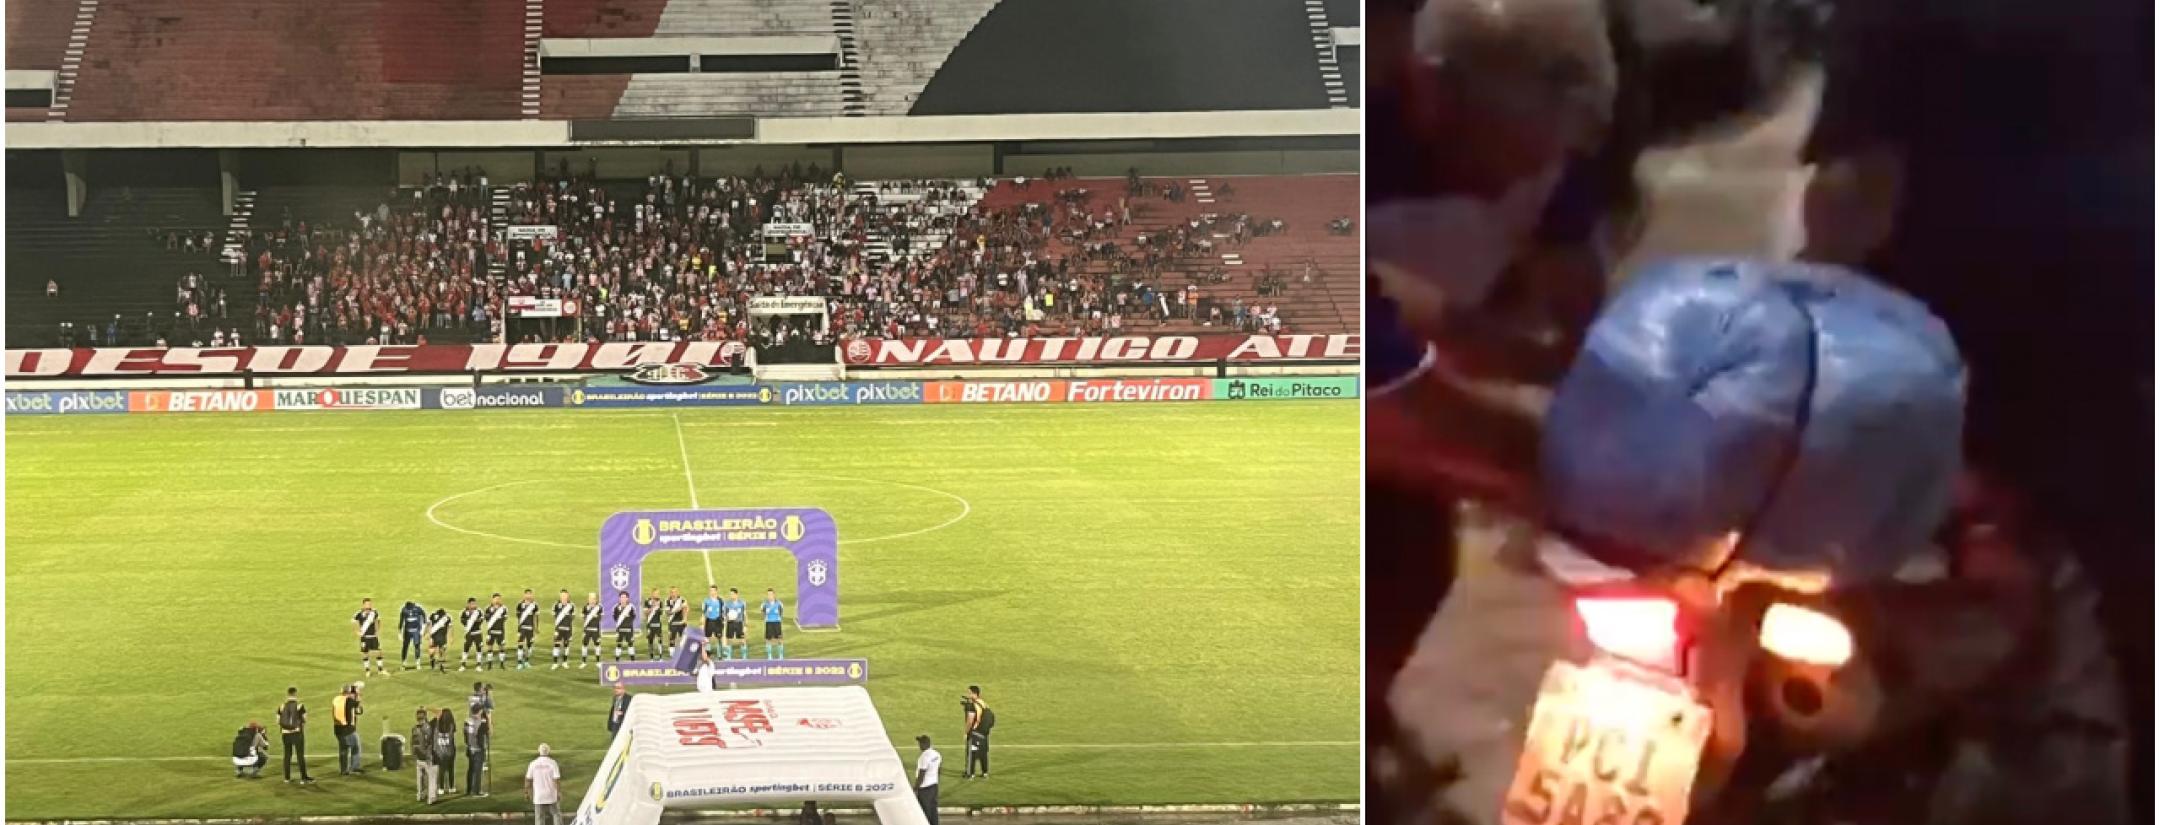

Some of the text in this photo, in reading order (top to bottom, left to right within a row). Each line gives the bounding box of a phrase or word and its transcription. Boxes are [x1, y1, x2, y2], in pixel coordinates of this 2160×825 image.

[5, 345, 414, 375] DESDE
[277, 389, 416, 408] MARQUESPAN
[440, 389, 544, 407] betnacional
[785, 383, 849, 405] pixbet
[857, 382, 920, 404] pixbet
[961, 382, 1050, 402] BETANO
[1067, 380, 1200, 402] Forteviron
[1250, 383, 1341, 397] Rei do Pitaco
[59, 391, 125, 413] pixbet
[167, 390, 258, 411] BETANO
[660, 516, 777, 531] BRASILEIRÃO
[666, 785, 746, 798] BRASILEIRÃO
[750, 783, 809, 793] sportingbet
[818, 783, 853, 792] SÉRIE
[865, 782, 895, 792] 2022
